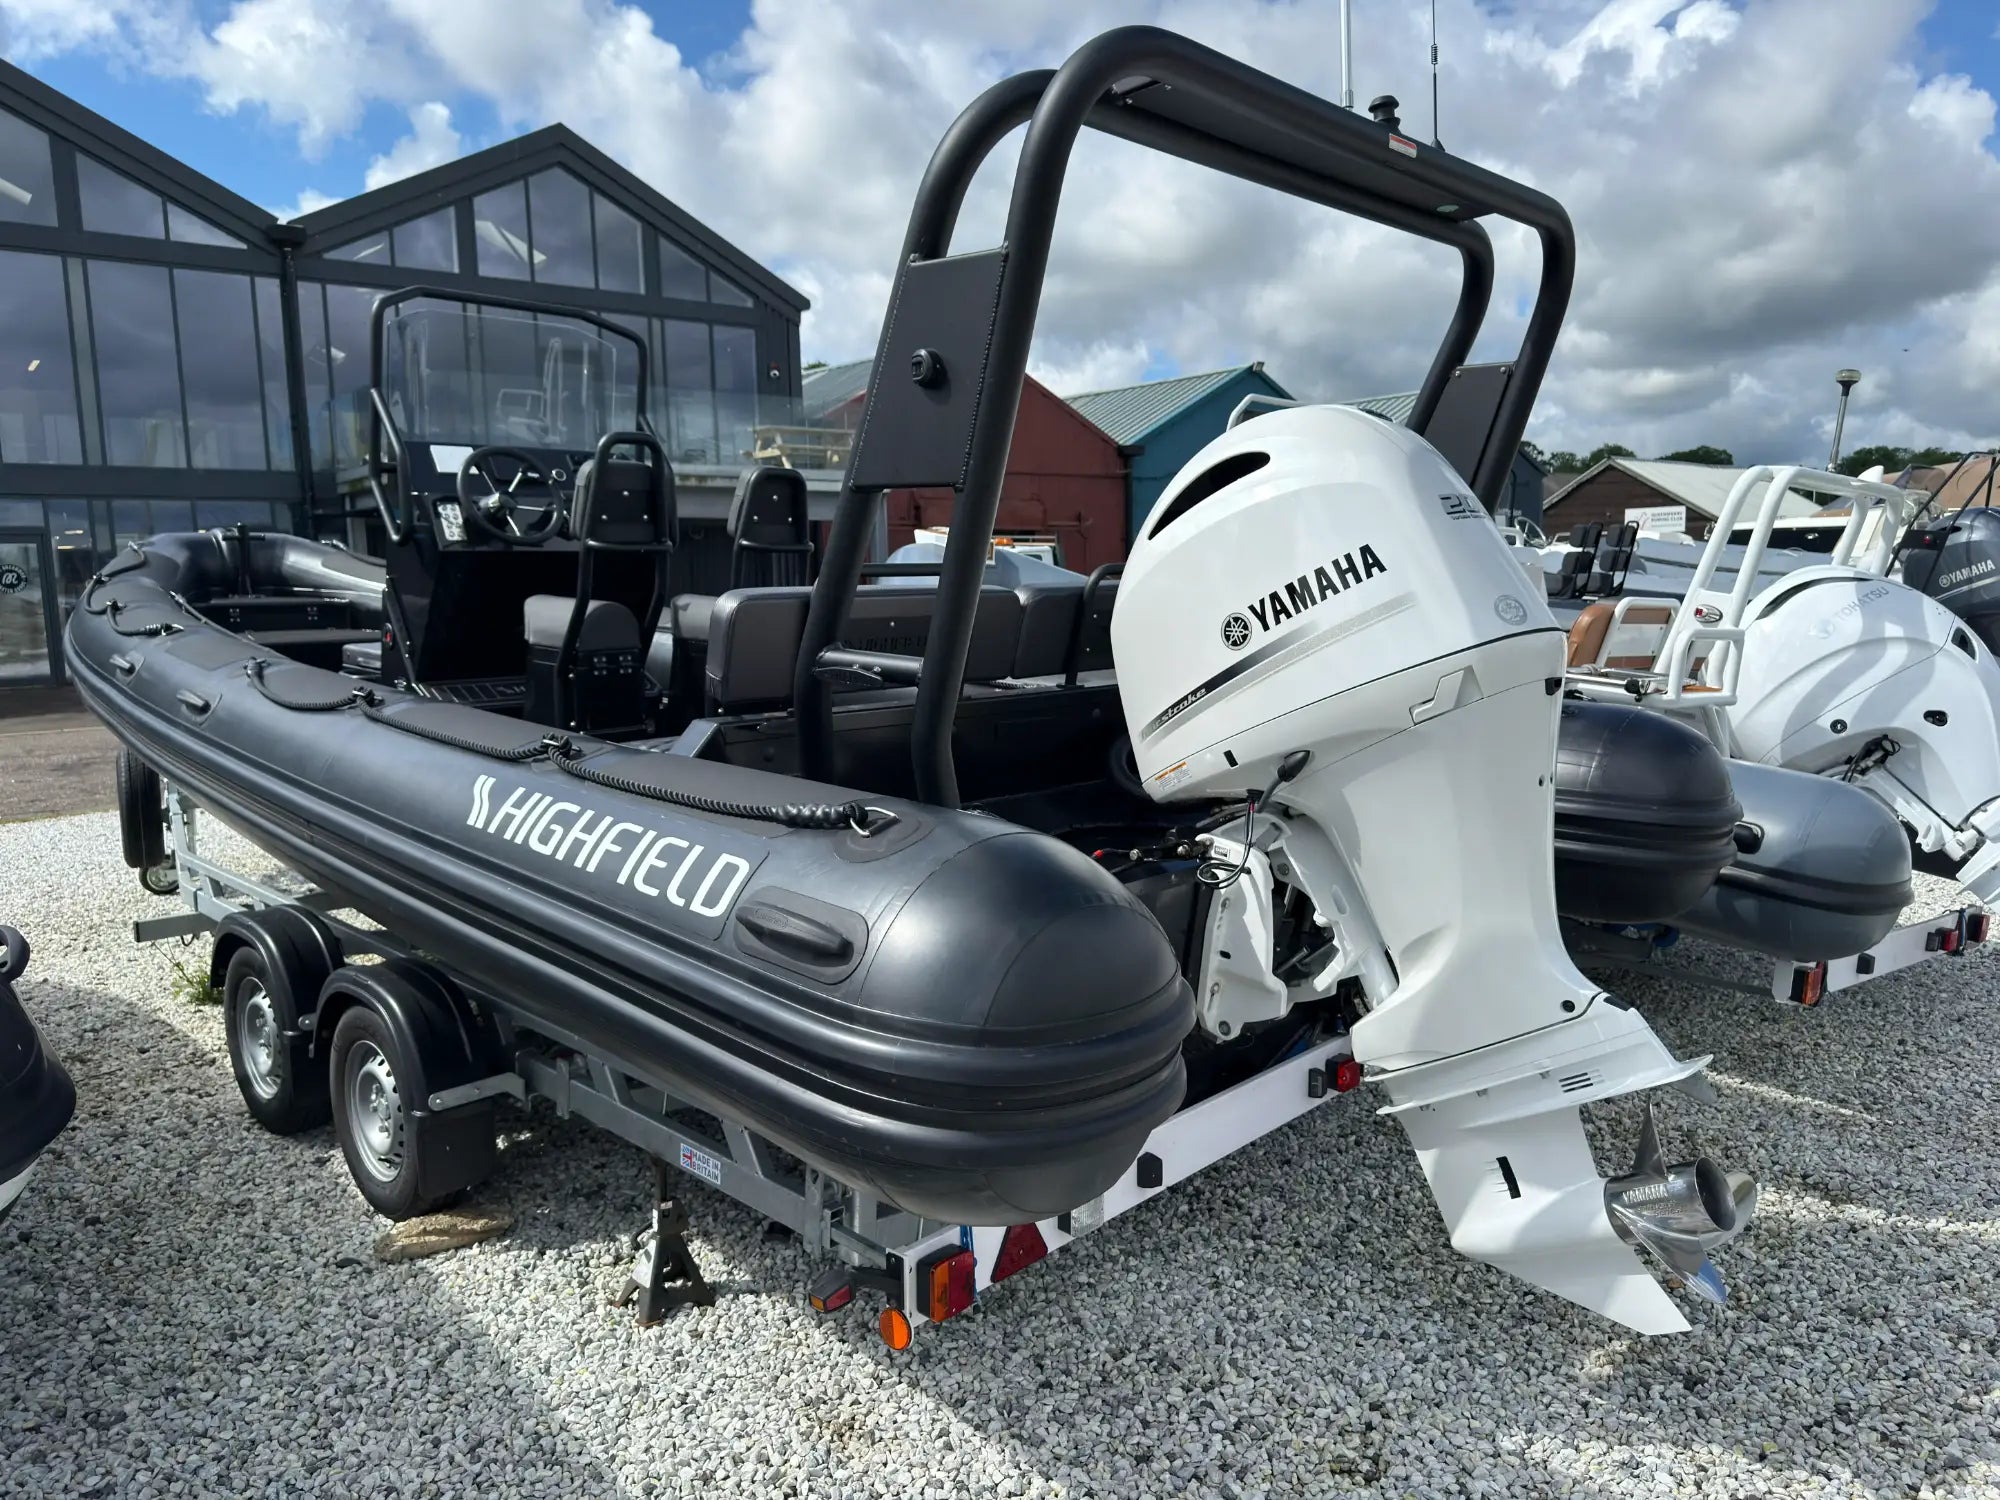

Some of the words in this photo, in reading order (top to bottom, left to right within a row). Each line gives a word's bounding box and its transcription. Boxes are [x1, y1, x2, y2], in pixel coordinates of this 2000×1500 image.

[1949, 559, 1996, 583] YAMAHA
[1248, 544, 1388, 633] YAMAHA
[1832, 586, 1890, 622] TOHATSU
[487, 786, 750, 918] HIGHFIELD
[693, 1150, 711, 1168] MADE
[693, 1160, 719, 1183] BRITAIN
[1622, 1183, 1668, 1205] YAMAHA
